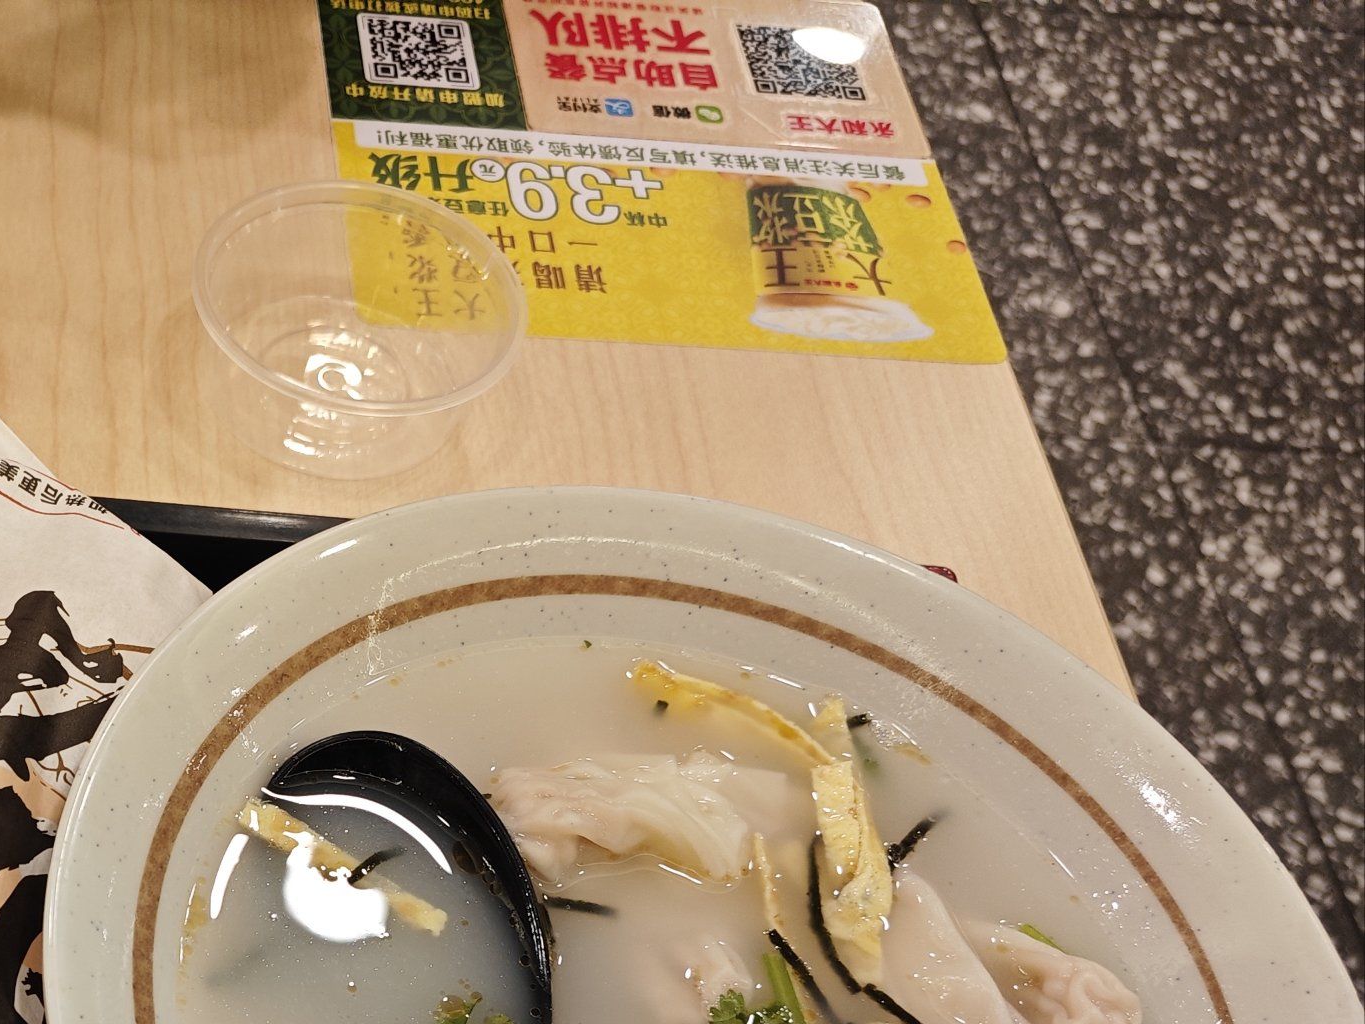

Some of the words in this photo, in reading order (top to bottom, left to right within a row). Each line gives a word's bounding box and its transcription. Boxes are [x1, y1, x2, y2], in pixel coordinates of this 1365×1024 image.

[529, 9, 711, 55] 不排队
[545, 53, 719, 91] 自助点餐
[345, 83, 505, 108] 加盟申请开放中
[557, 101, 602, 114] 支付宝
[651, 104, 691, 120] 微信
[786, 115, 895, 139] 永和大王
[367, 152, 475, 195] 升级
[623, 211, 668, 228] 中杯
[752, 191, 874, 252] 茶豆浆
